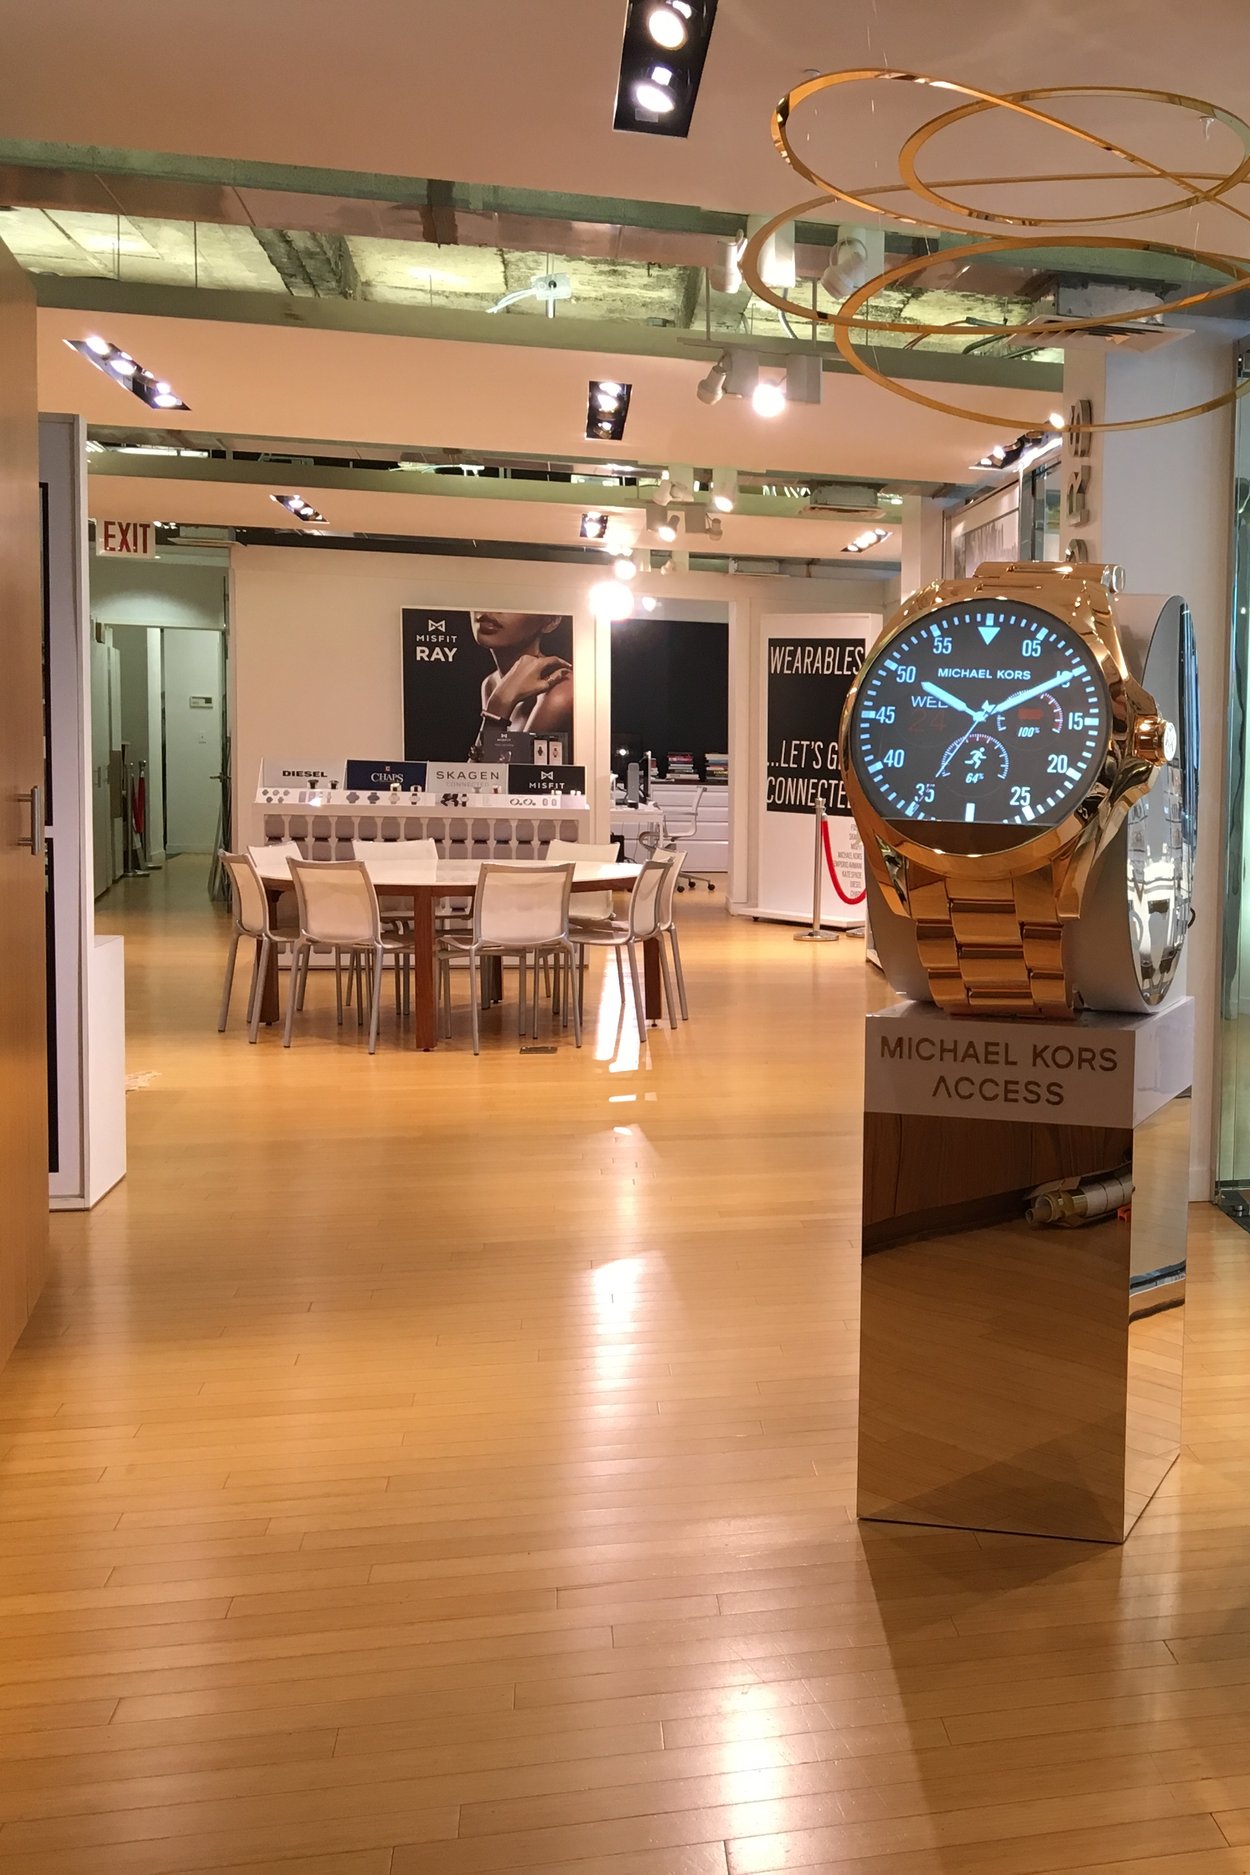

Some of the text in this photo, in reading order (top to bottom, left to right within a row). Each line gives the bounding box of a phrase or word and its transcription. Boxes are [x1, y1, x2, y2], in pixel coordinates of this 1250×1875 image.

[103, 521, 151, 554] EXIT
[416, 634, 458, 643] MISFIT
[932, 637, 952, 655] 55
[1021, 639, 1042, 657] 05
[416, 646, 458, 662] RAY
[770, 646, 865, 676] WEARABLES
[896, 665, 917, 684] 50
[937, 668, 1031, 680] MICHAEL KORS
[875, 706, 896, 724] 45
[1068, 712, 1084, 731] 15
[883, 749, 905, 768] 40
[1046, 754, 1068, 774] 20
[282, 770, 328, 778] DIESEL
[370, 772, 404, 783] CHAPS
[436, 770, 500, 780] SKAGEN
[528, 782, 565, 790] MISFIT
[767, 776, 852, 809] CONNECTE
[914, 783, 936, 803] 35
[1009, 786, 1031, 806] 25
[880, 1035, 1118, 1072] MICHAEL KORS
[932, 1075, 1065, 1106] ACCESS
